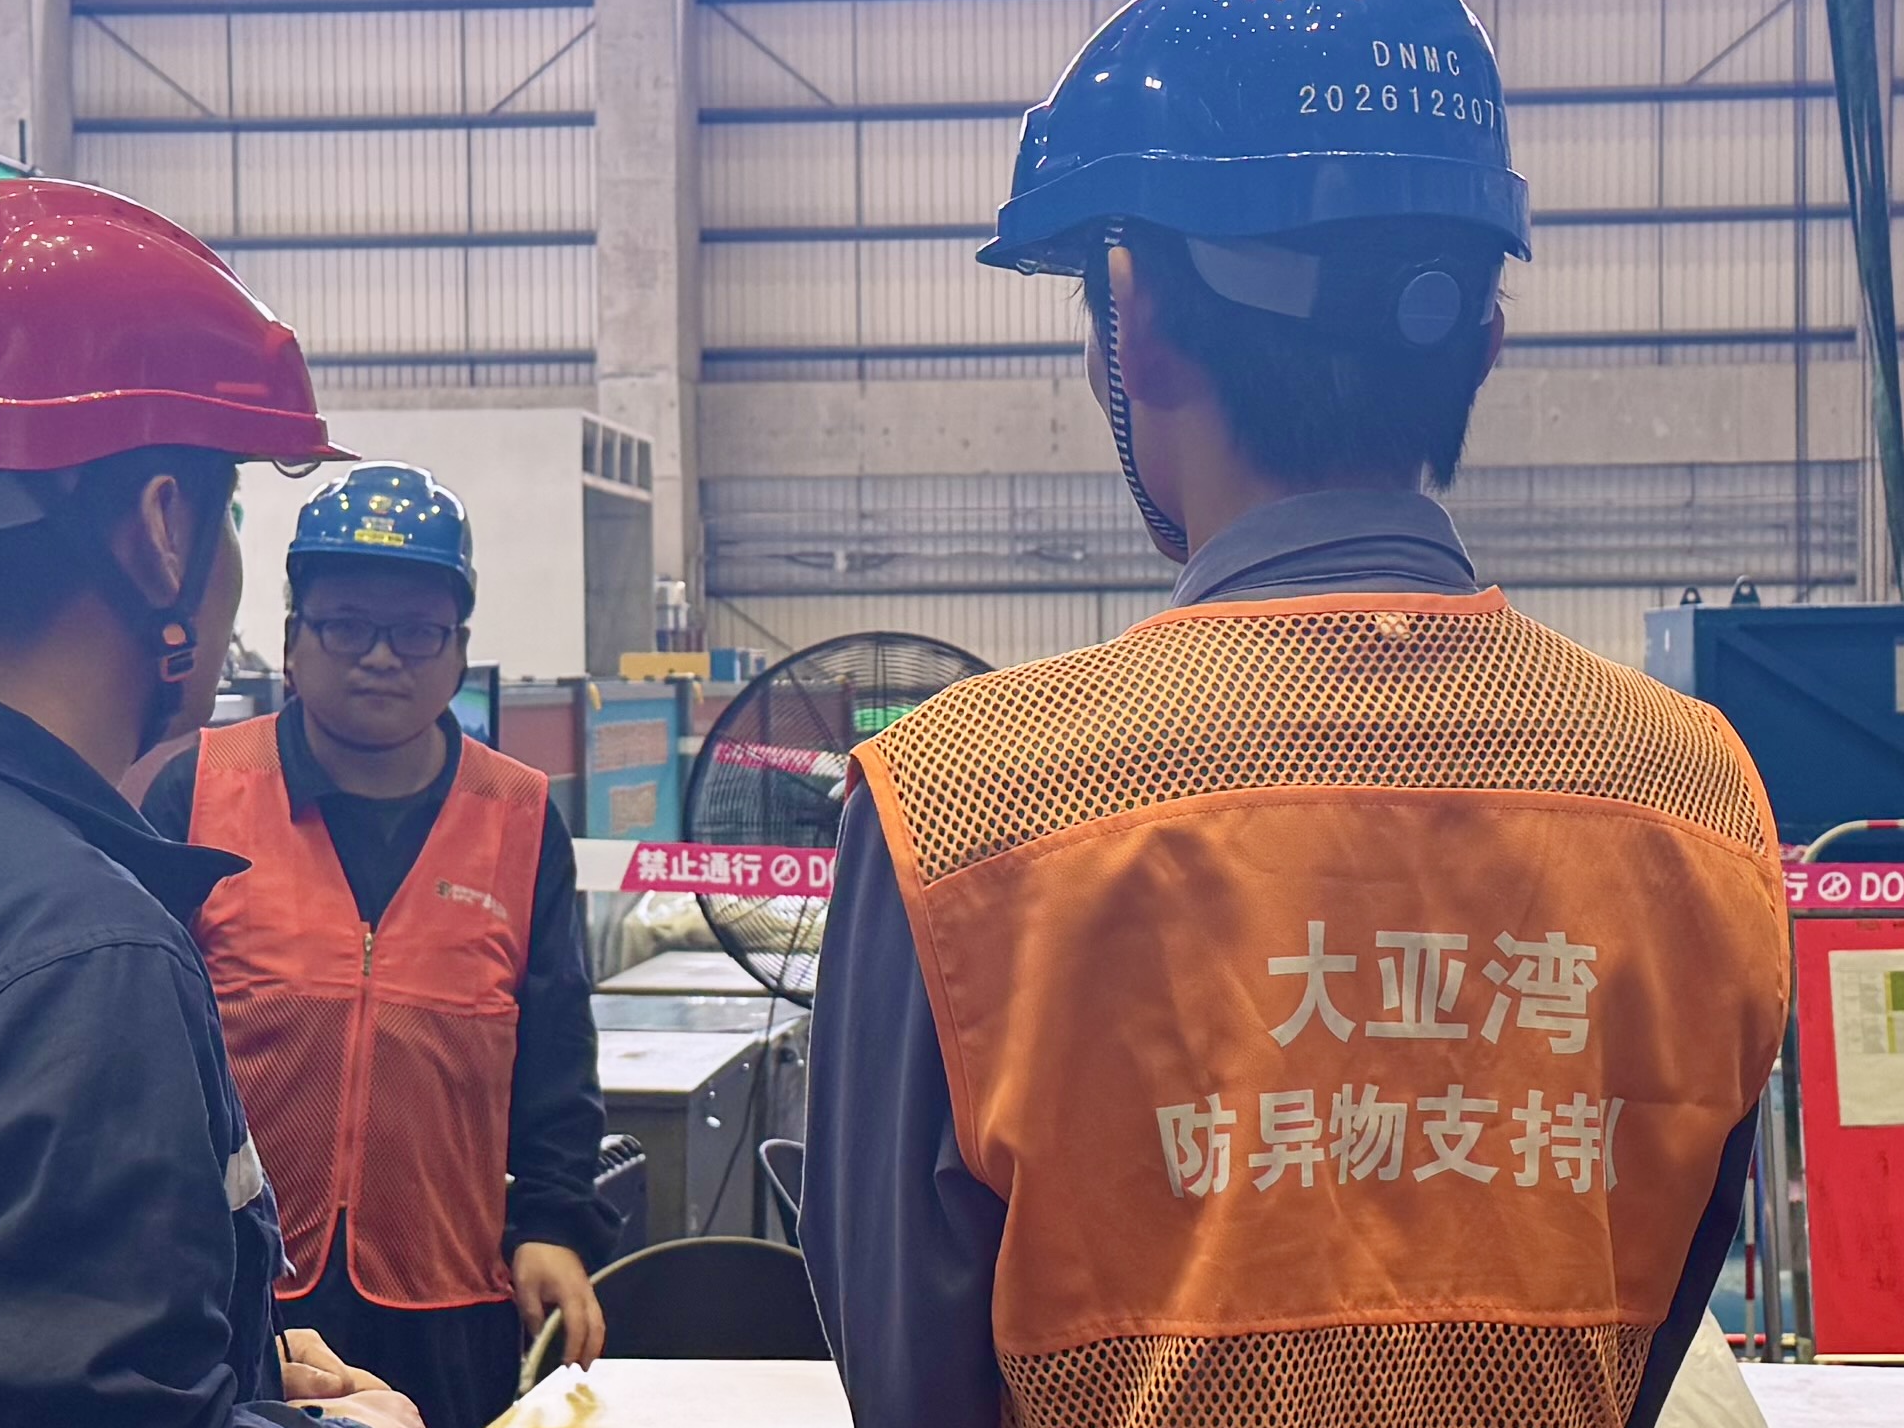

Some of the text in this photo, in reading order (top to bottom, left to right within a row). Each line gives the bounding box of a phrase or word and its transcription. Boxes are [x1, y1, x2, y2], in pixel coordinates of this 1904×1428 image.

[1373, 40, 1460, 76] DNMC
[637, 847, 763, 888] 禁止通行
[808, 855, 834, 889] D
[1267, 920, 1598, 1055] 大亚湾
